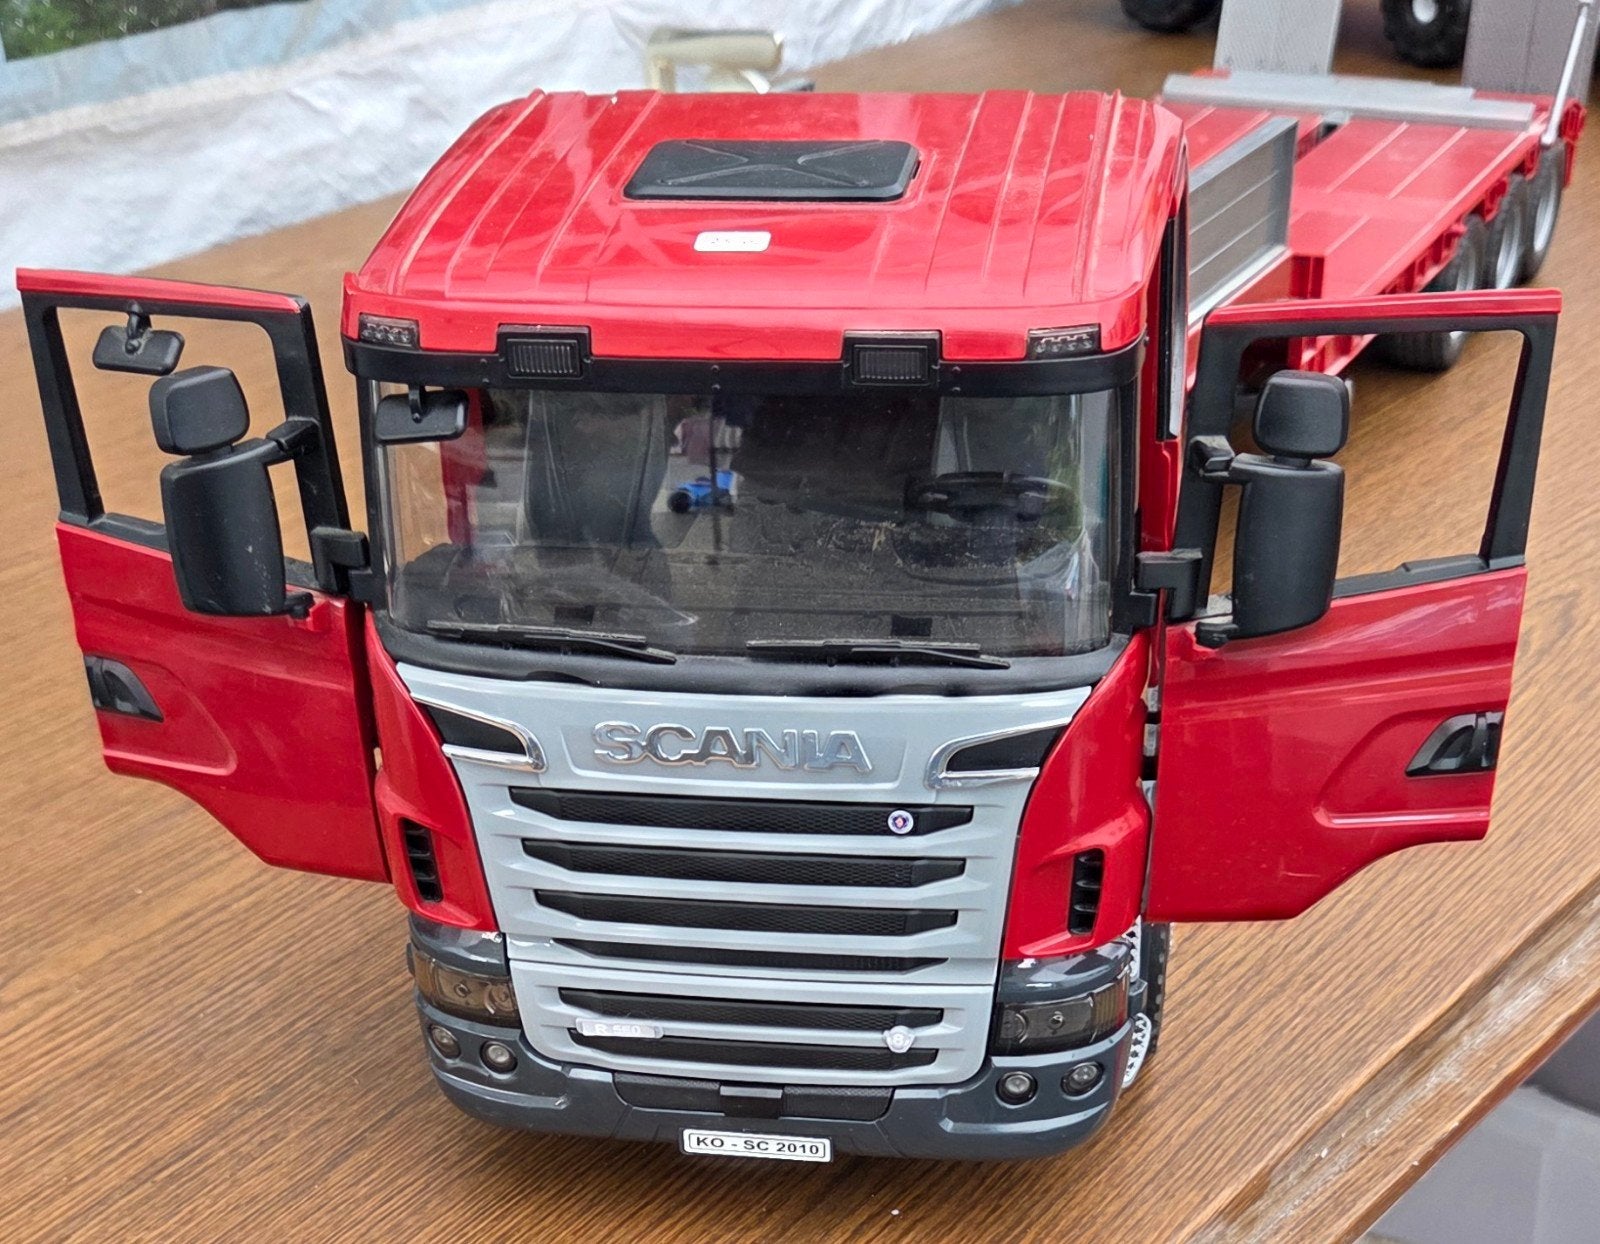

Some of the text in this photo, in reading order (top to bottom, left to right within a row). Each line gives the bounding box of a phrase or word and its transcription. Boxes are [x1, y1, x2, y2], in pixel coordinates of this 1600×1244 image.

[592, 720, 873, 773] SCANIA
[594, 1023, 608, 1035] R
[696, 1136, 724, 1148] KO
[743, 1139, 769, 1151] SC
[776, 1142, 819, 1155] 2010
